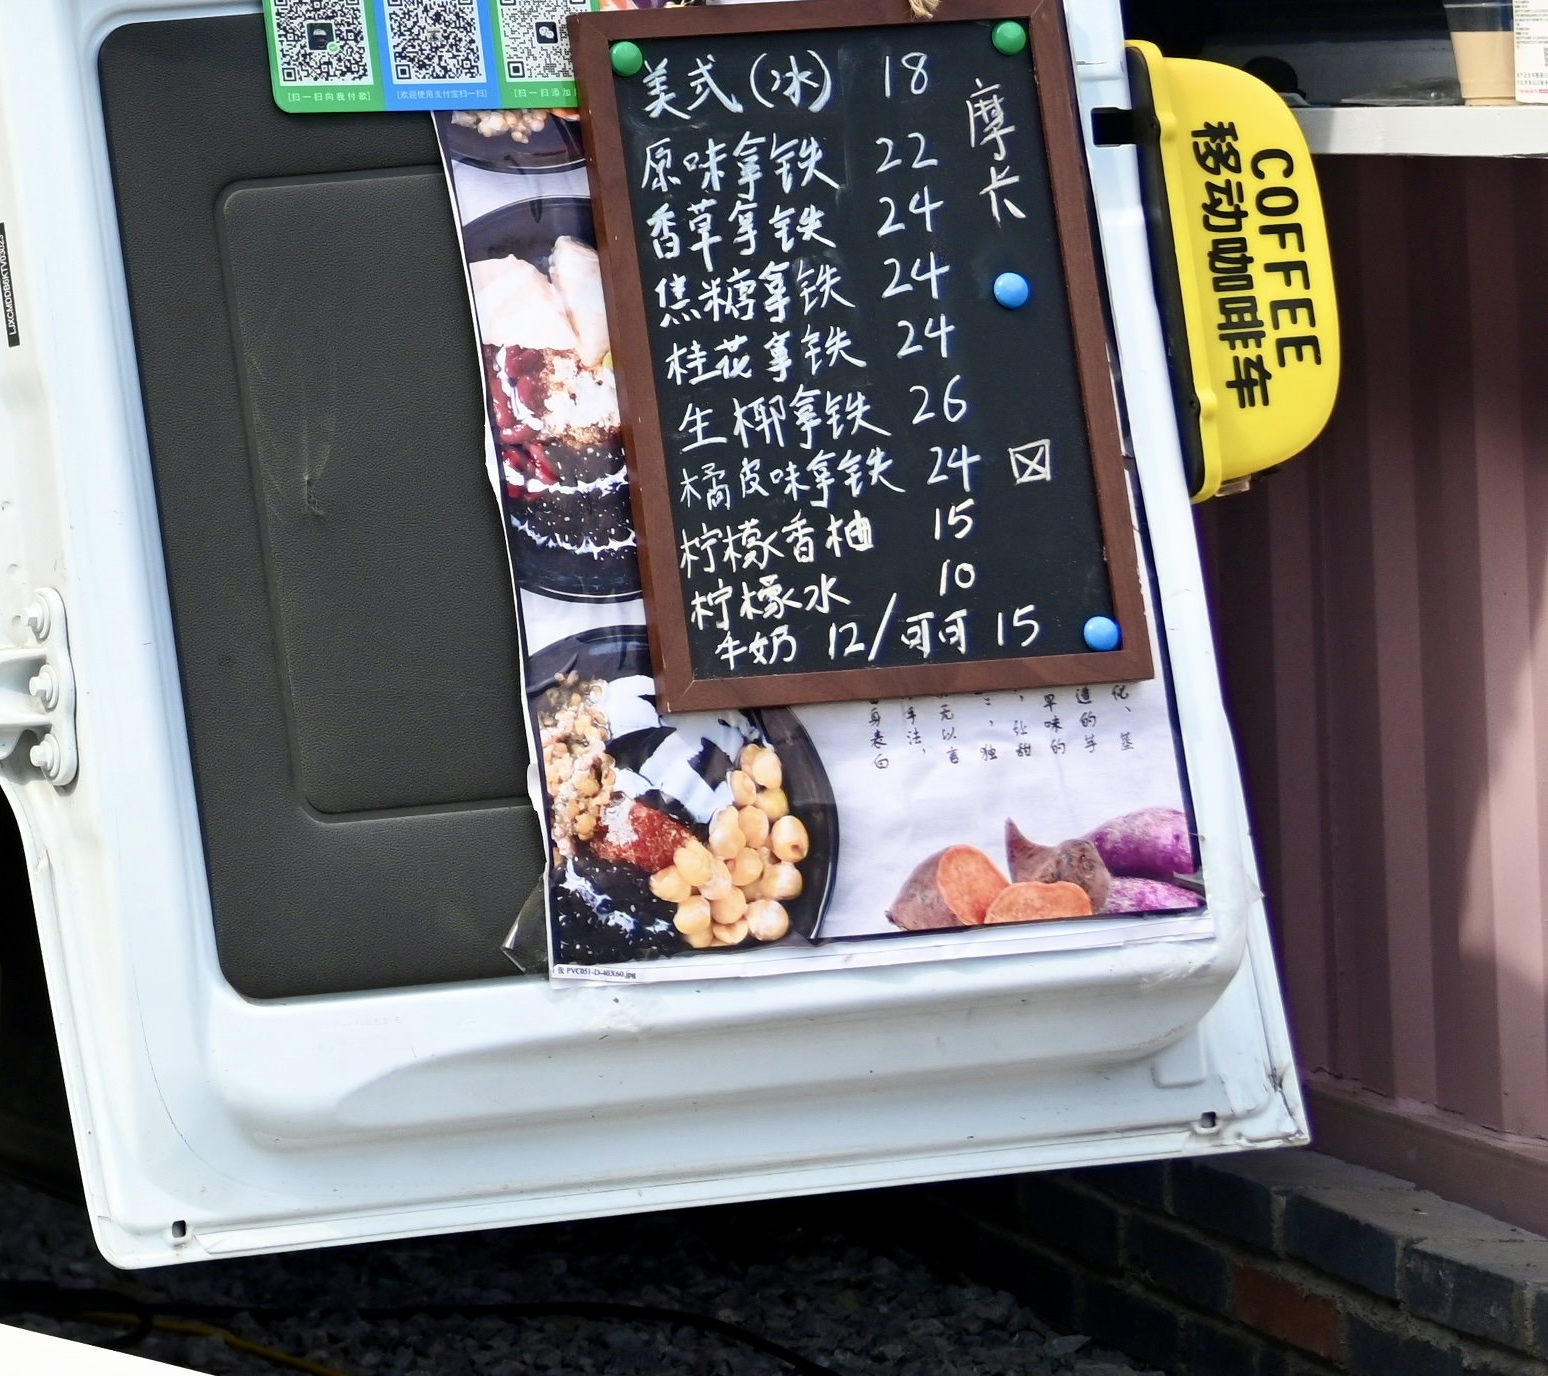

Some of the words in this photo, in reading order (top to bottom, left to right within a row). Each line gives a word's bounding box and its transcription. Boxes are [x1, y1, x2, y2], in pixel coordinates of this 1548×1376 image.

[883, 51, 930, 99] 18
[640, 130, 843, 200] 原味拿铁
[875, 131, 939, 174] 22
[965, 77, 1027, 228] 摩卡
[646, 197, 837, 272] 香草拿铁
[876, 185, 944, 238] 24
[1190, 120, 1273, 409] 移动咖啡车
[1251, 148, 1323, 368] COFFEE
[655, 259, 856, 329] 焦糖拿铁
[881, 251, 950, 300] 24
[665, 323, 867, 386] 桂花拿铁
[896, 313, 955, 359] 24
[678, 383, 892, 452] 生椰拿铁
[909, 374, 967, 426] 26
[679, 446, 906, 511] 橘皮味拿铁
[927, 444, 982, 492] 24
[679, 510, 874, 580] 柠檬香柚
[934, 498, 974, 541] 15
[690, 573, 850, 630] 柠檬水
[939, 559, 975, 597] 10
[714, 623, 797, 670] 牛奶
[998, 604, 1039, 647] 15
